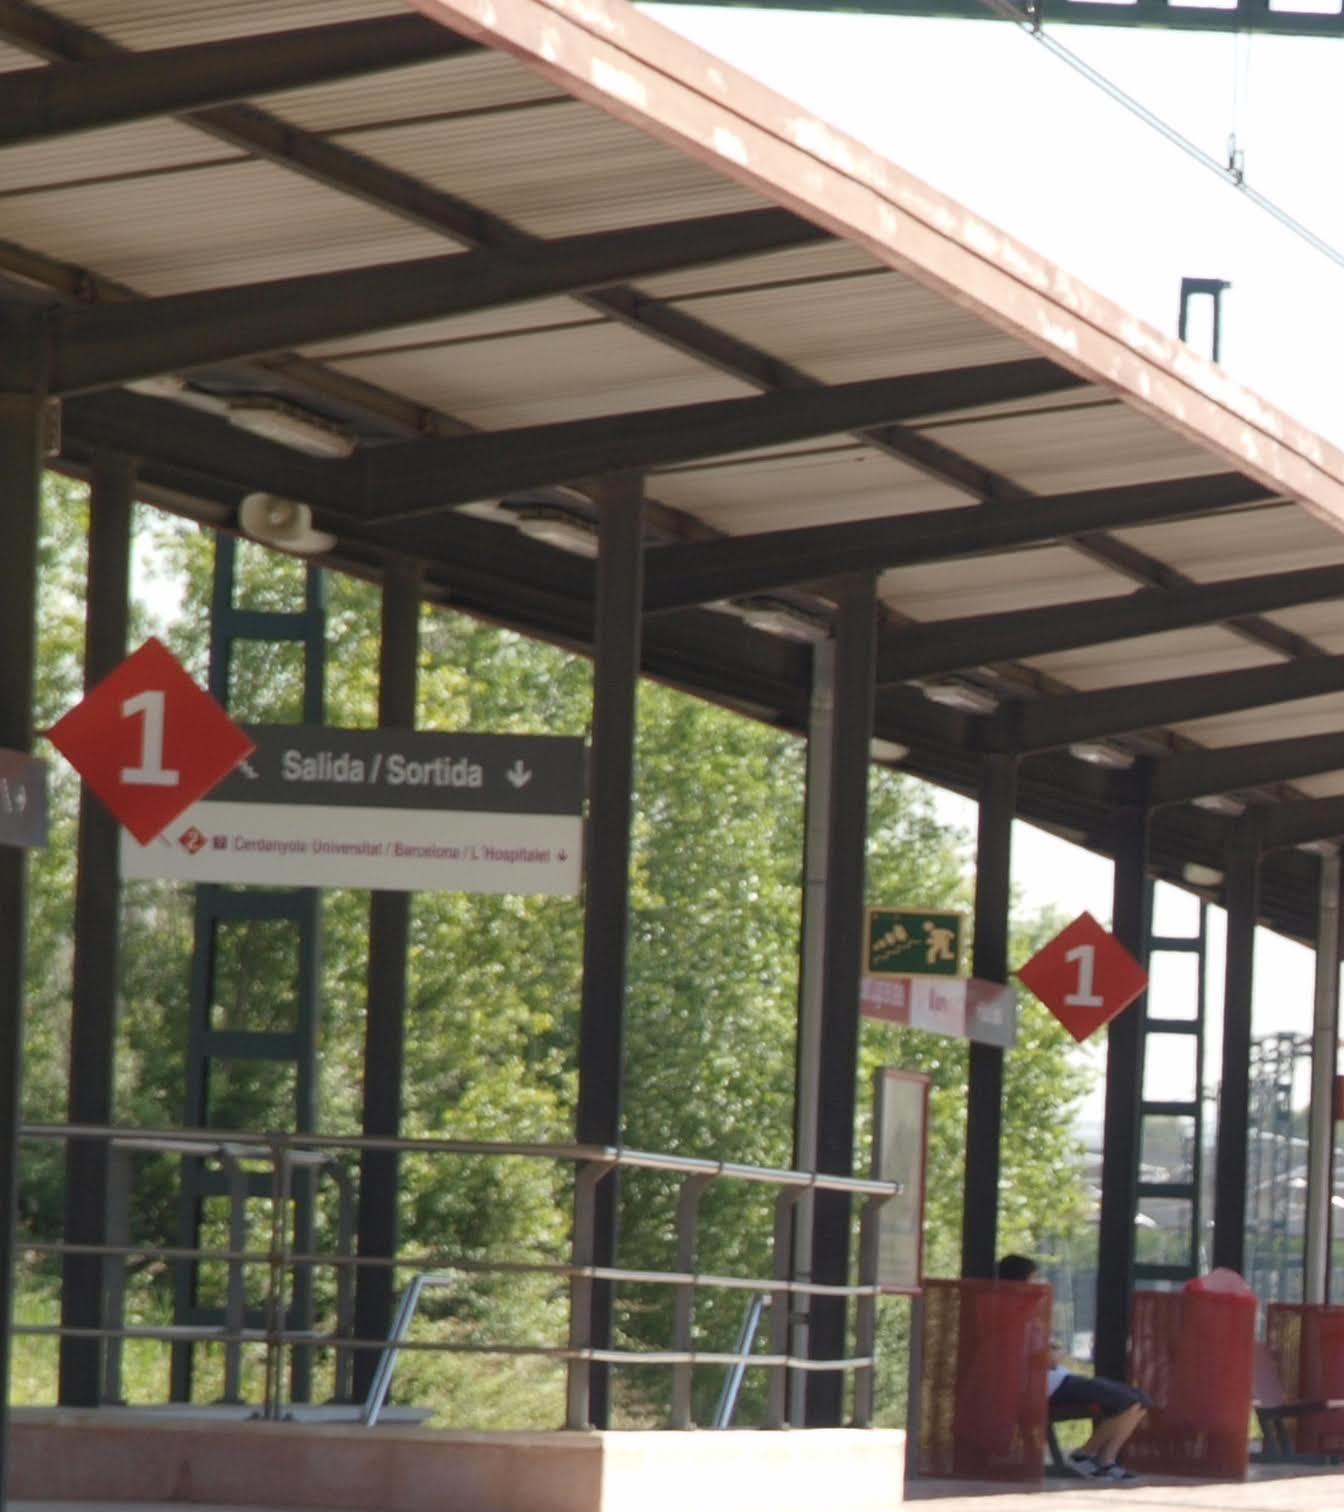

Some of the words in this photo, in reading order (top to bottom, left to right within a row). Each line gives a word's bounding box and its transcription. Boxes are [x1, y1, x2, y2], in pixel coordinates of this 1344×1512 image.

[119, 689, 179, 786] 1
[281, 749, 365, 782] Salida
[386, 753, 484, 788] Sortida
[395, 842, 460, 860] Barcelona
[1063, 944, 1105, 1007] 1
